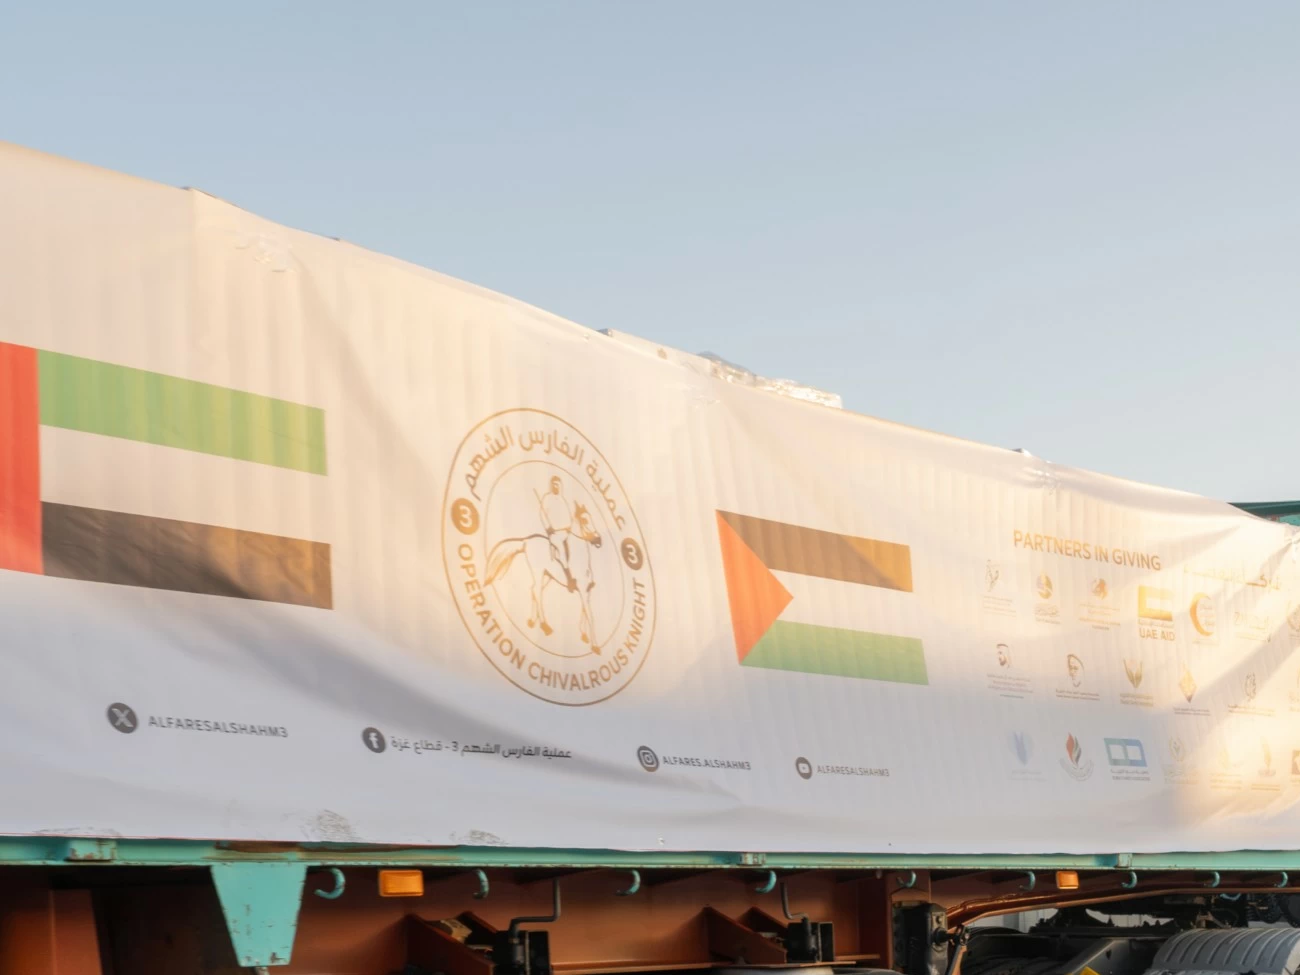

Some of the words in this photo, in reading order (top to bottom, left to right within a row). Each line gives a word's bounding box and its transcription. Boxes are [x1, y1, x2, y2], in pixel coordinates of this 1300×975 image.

[518, 428, 585, 466] الفارس
[465, 425, 514, 502] الشهم
[1013, 529, 1092, 560] PARTNERS
[1095, 545, 1109, 563] IN
[1112, 548, 1161, 571] GIVING
[457, 543, 529, 671] OPERATION
[527, 652, 629, 691] CHIVALROUS
[625, 577, 646, 655] KNIGHT
[1139, 627, 1158, 639] UAE
[1160, 629, 1176, 642] AID
[148, 716, 289, 738] ALFARESALSHAHM3
[390, 736, 410, 750] غزة
[414, 739, 441, 755] قطاع
[451, 741, 459, 751] 3
[461, 743, 501, 757] الشهم
[502, 745, 540, 759] الفارس
[543, 746, 572, 759] عملية
